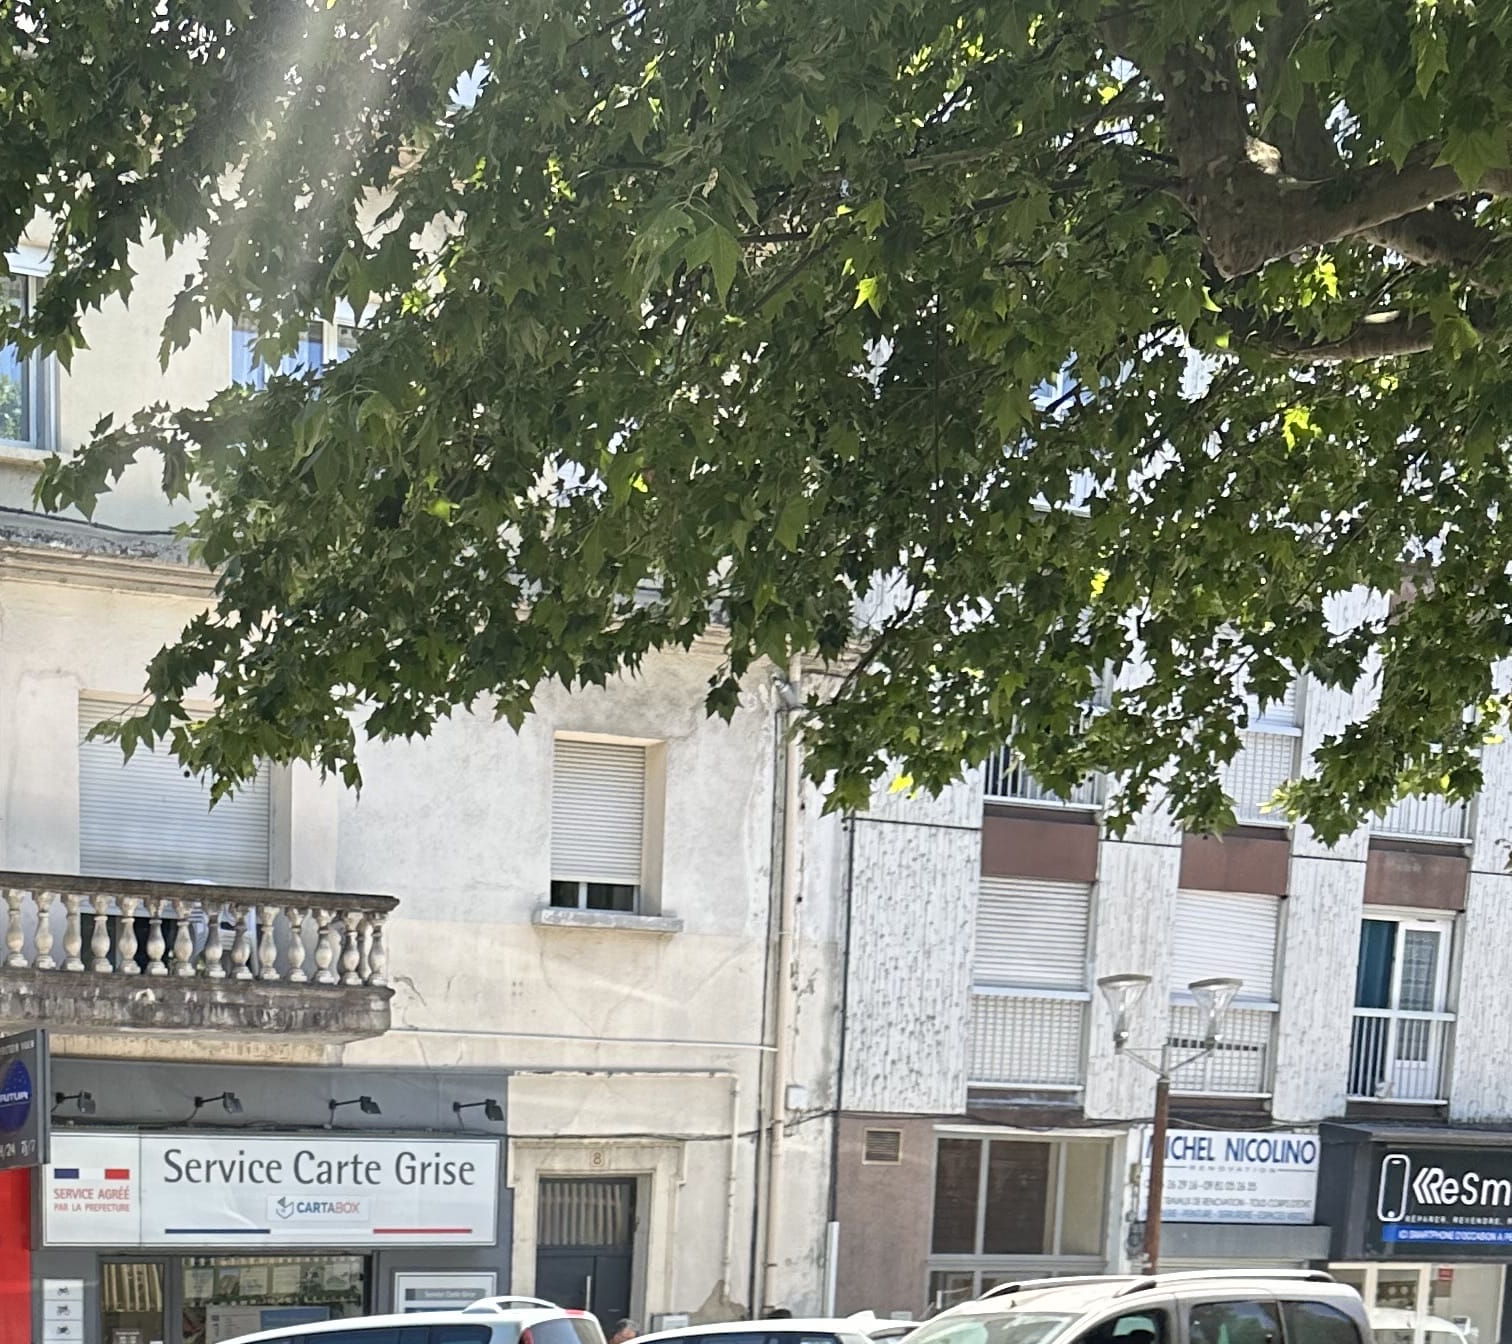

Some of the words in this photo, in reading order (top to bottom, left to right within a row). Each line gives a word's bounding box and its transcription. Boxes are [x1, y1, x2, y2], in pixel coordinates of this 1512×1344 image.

[1225, 1137, 1317, 1164] NICOLINO
[163, 1148, 283, 1184] Service
[292, 1150, 383, 1185] Carte
[394, 1151, 476, 1186] Grise
[53, 1187, 95, 1200] SERVICE
[54, 1202, 69, 1212] PAR
[72, 1203, 82, 1212] LA
[296, 1201, 360, 1214] CARTABOX
